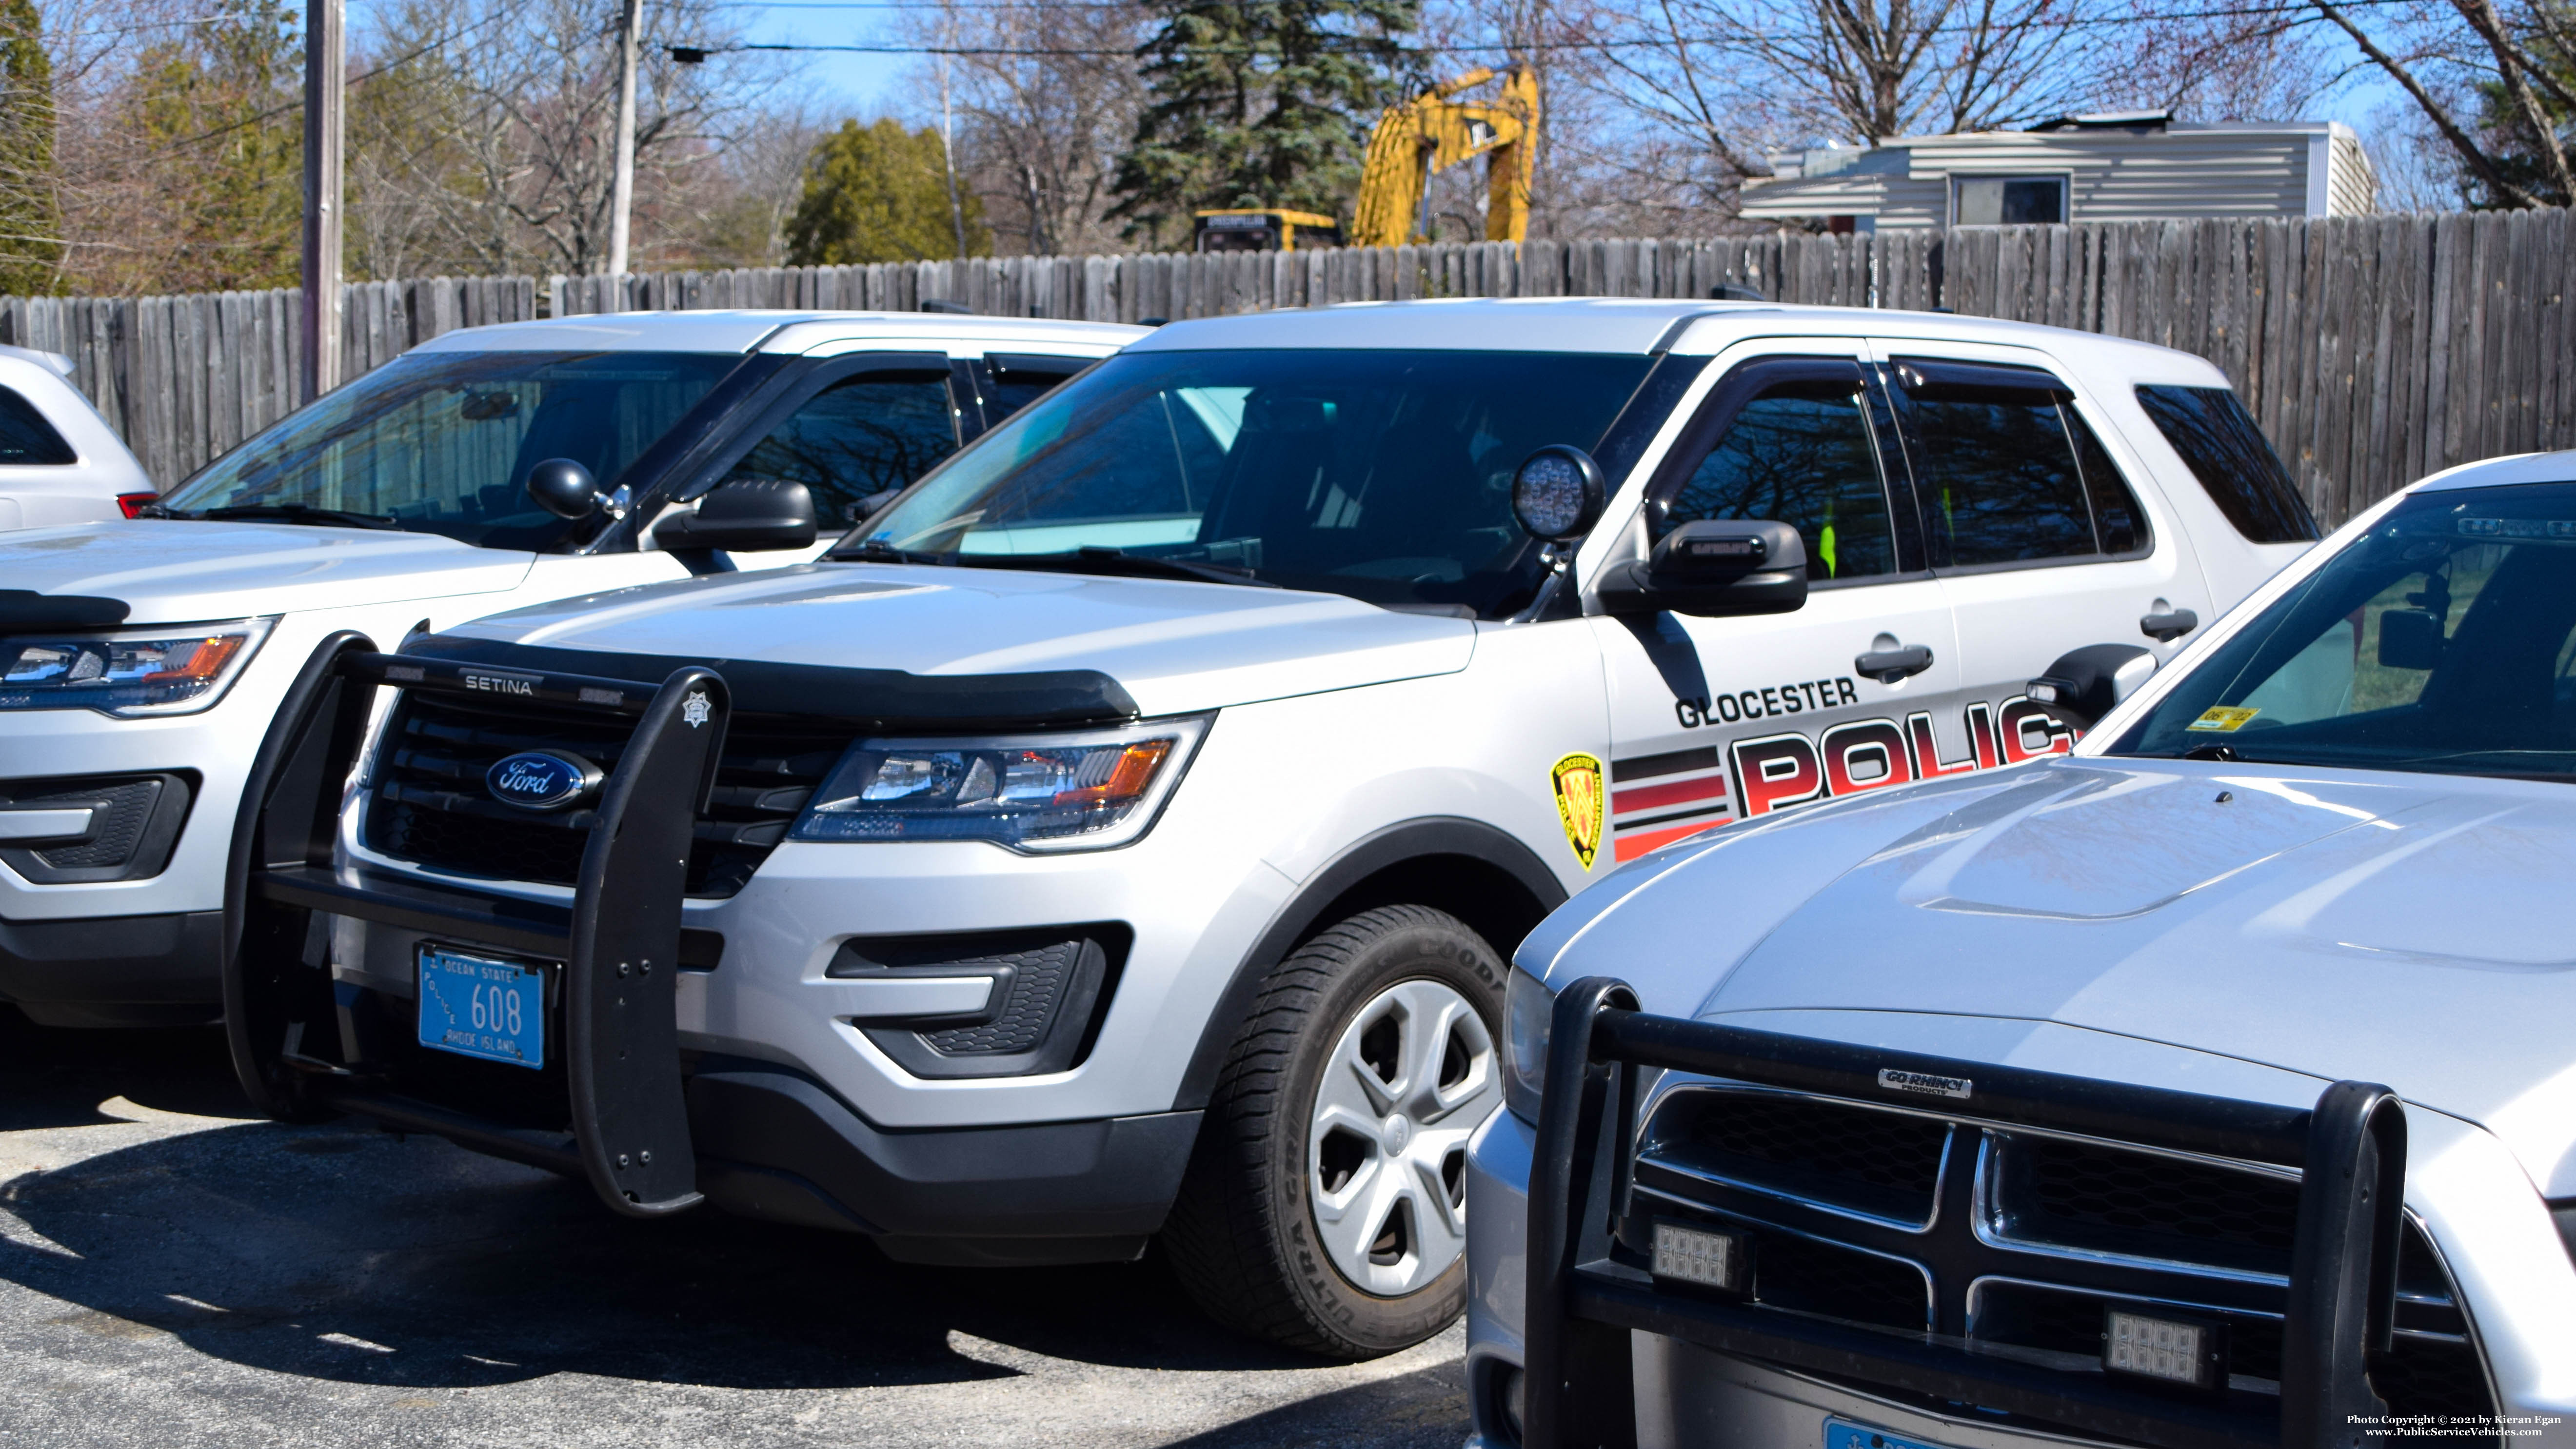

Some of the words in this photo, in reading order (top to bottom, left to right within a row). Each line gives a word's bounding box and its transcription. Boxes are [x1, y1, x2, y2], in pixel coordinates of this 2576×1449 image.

[465, 675, 533, 695] SETINA
[1675, 676, 1858, 728] GLOCESTER
[1728, 695, 2086, 817] POLIC
[499, 760, 555, 794] Ford
[1558, 794, 1577, 843] POLICE
[445, 960, 475, 976] OCEAN
[482, 968, 513, 983] STATE
[472, 983, 521, 1036] 608
[446, 1029, 476, 1047] RHODE
[481, 1036, 515, 1053] ISLAND
[1886, 1071, 1908, 1083] GO
[1290, 1220, 1355, 1326] ULTRA
